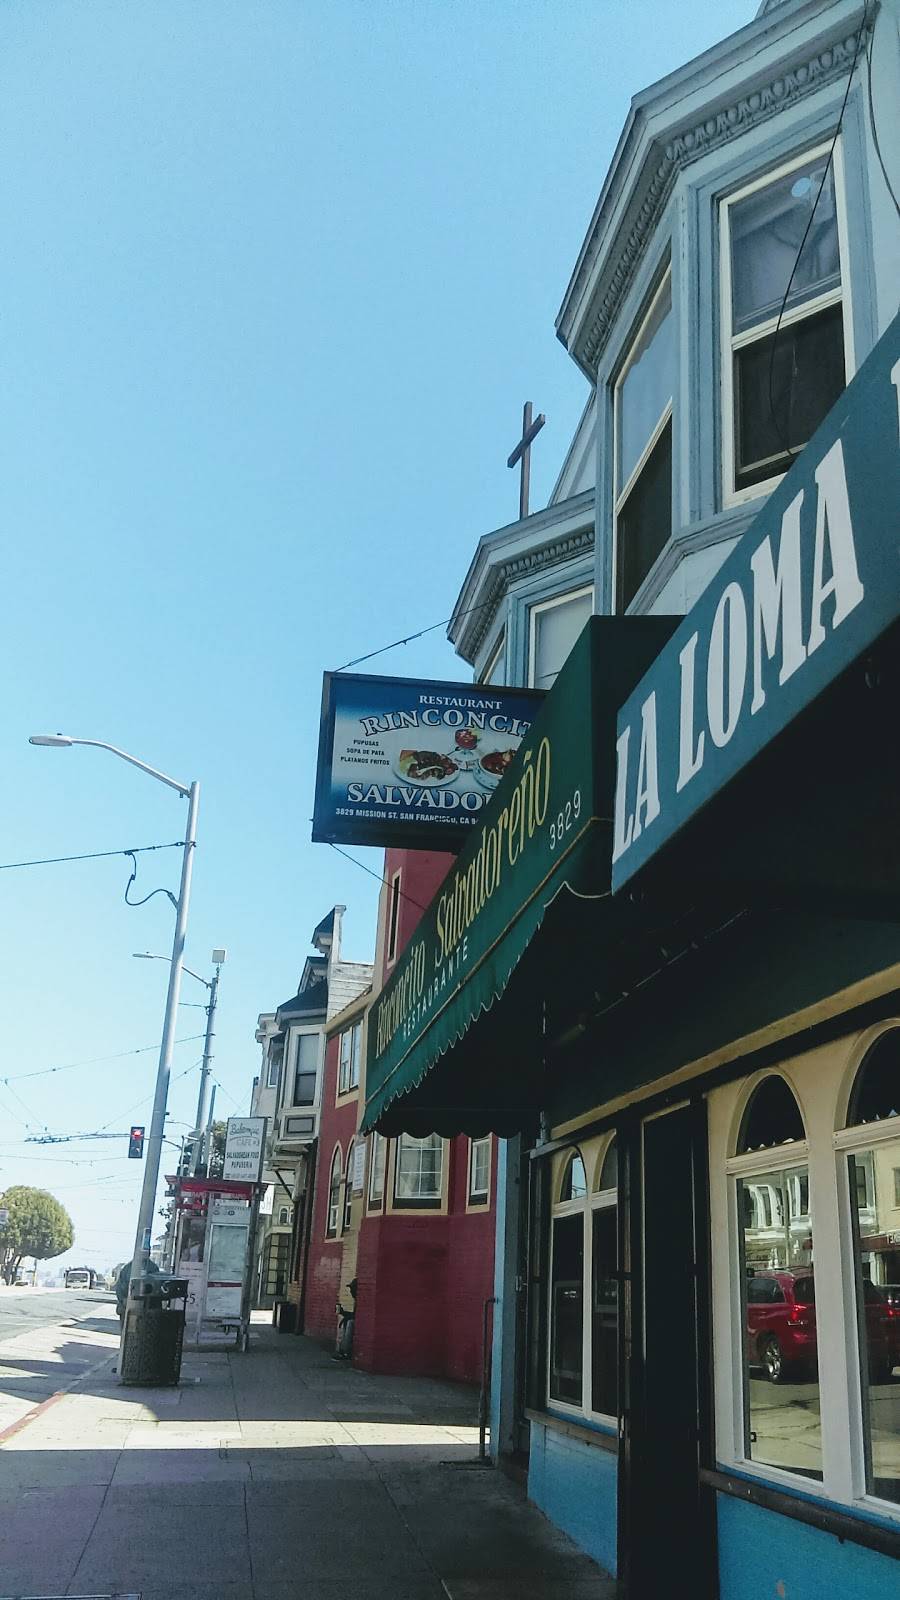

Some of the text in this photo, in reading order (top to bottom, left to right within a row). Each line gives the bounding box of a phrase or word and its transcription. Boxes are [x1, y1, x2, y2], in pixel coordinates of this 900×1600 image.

[612, 438, 865, 863] LA LOMA
[419, 695, 503, 710] RESTAURANT
[346, 747, 361, 755] SOPA
[353, 739, 379, 747] PUPUSAS
[340, 756, 390, 766] PLATANOS FRITOS
[335, 807, 354, 816] 3829
[355, 809, 386, 819] MISSION
[400, 812, 414, 820] SAN
[459, 816, 470, 824] CA
[549, 789, 582, 850] 3829
[434, 736, 551, 969] Salvadoreño
[402, 935, 468, 1042] RESTAURANTE
